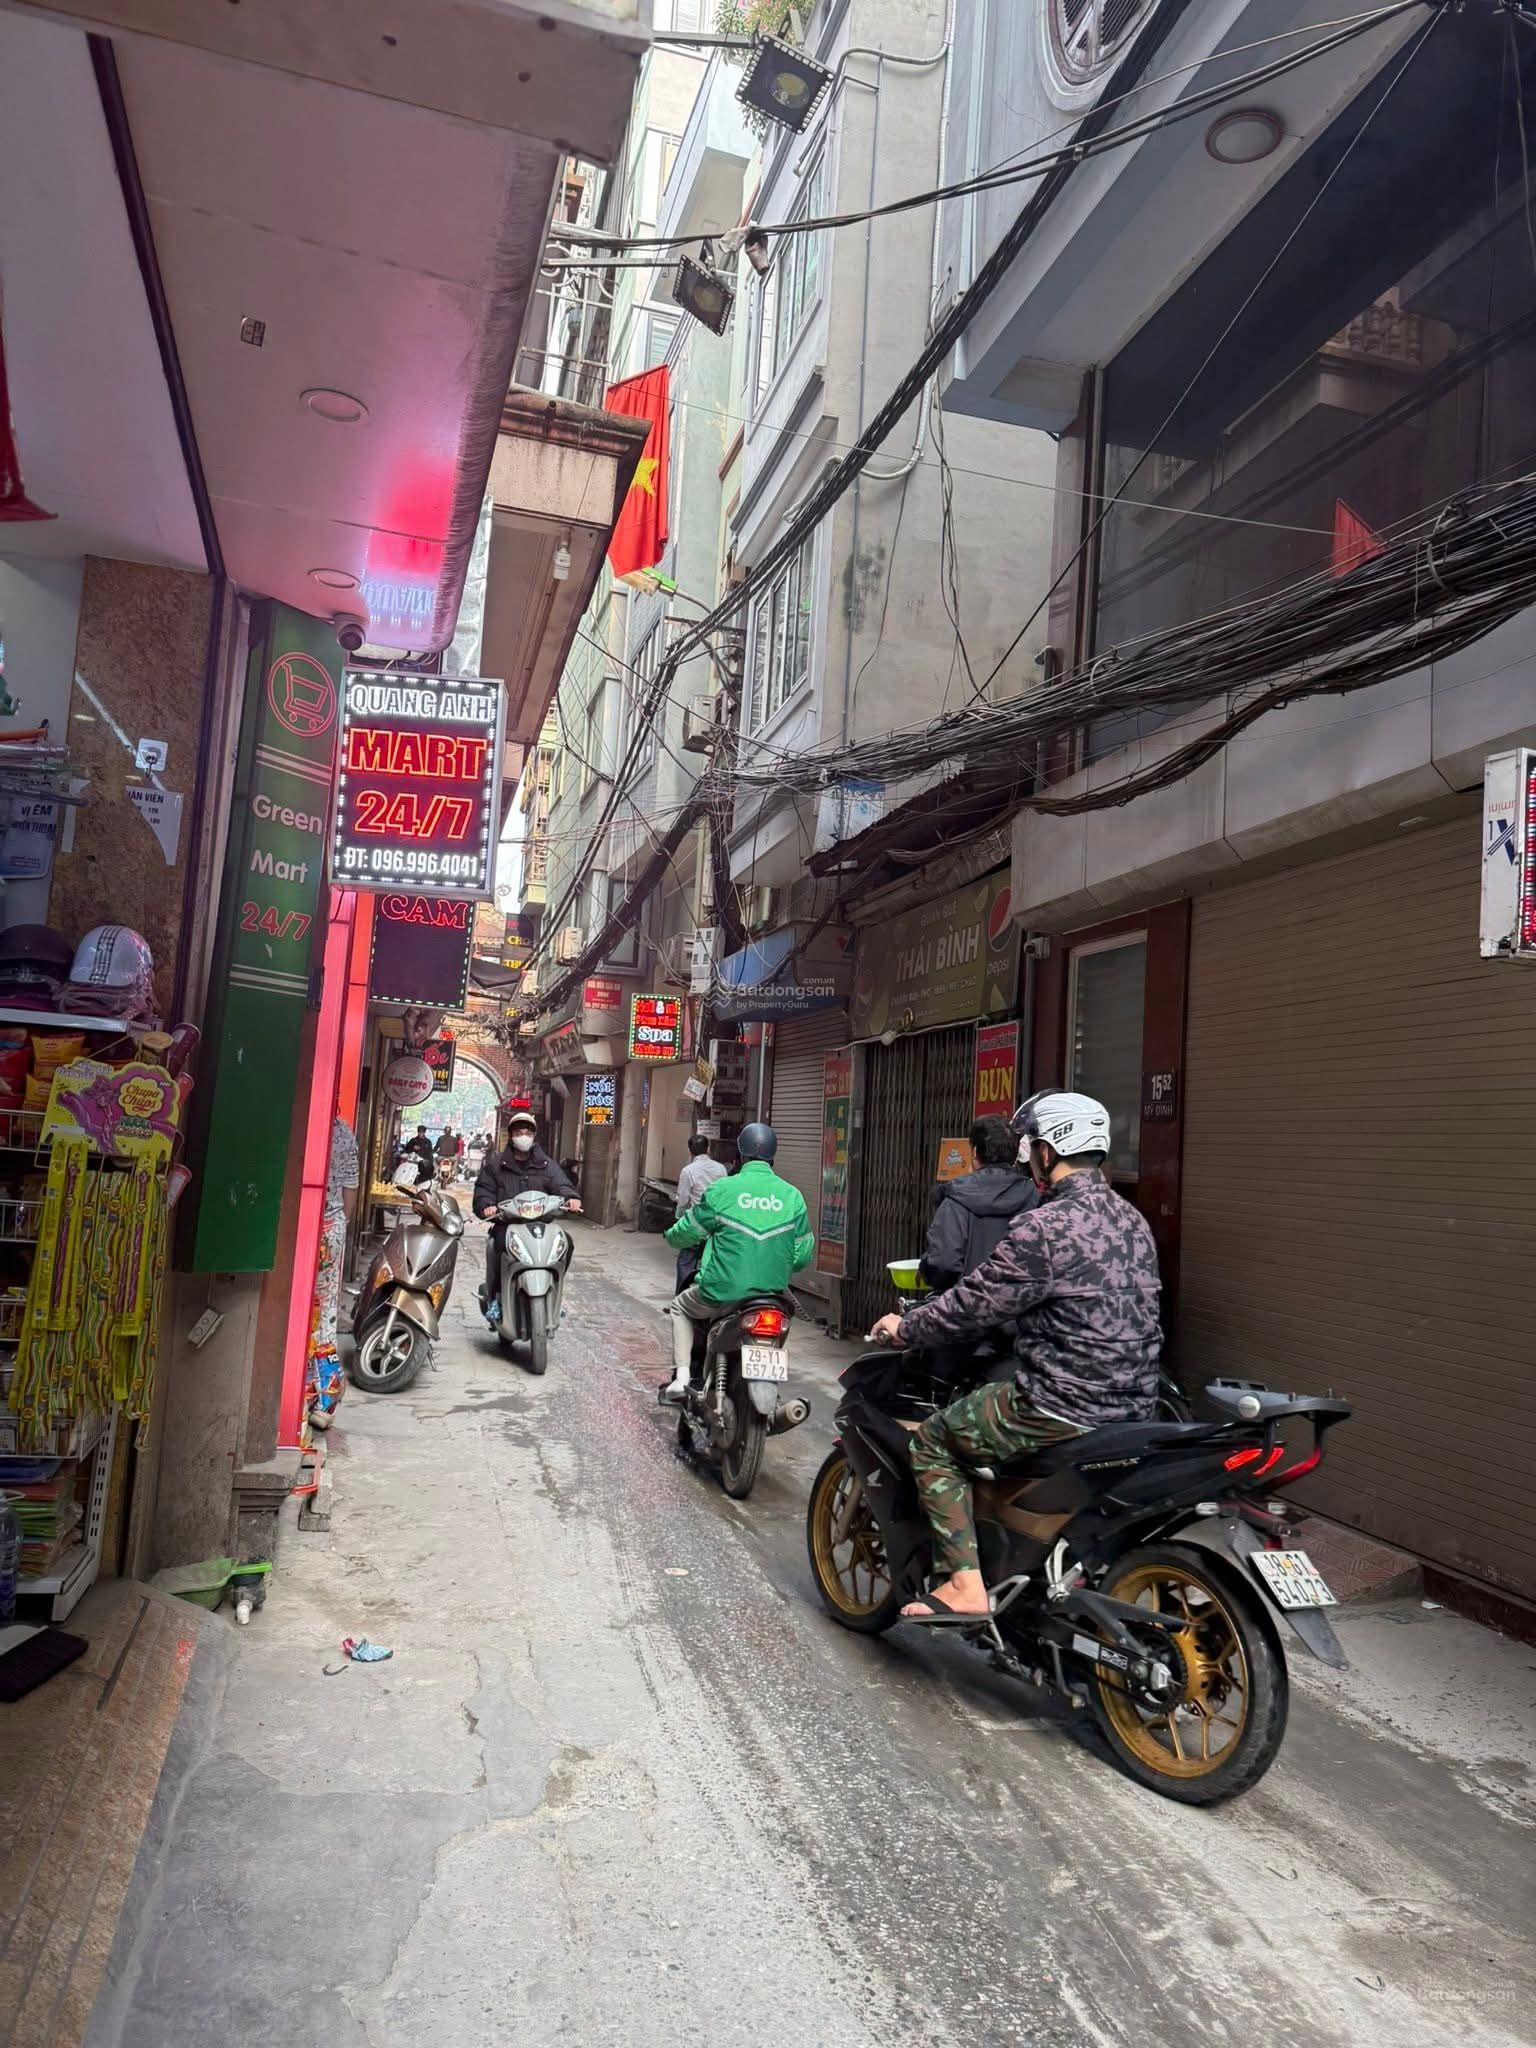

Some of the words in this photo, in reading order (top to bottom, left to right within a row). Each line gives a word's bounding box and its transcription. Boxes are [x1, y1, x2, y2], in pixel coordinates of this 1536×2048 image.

[351, 684, 436, 718] QUANG
[439, 692, 493, 722] ANH
[348, 728, 488, 780] MART
[251, 794, 323, 835] Green
[354, 789, 474, 840] 24/7
[250, 849, 309, 883] Mart
[372, 849, 478, 877] 096.996.4041
[239, 901, 312, 939] 24/7
[896, 936, 932, 983] THÁI
[935, 923, 981, 971] BÌNH
[637, 1025, 673, 1042] Spa
[126, 1084, 160, 1099] Chupa
[978, 1057, 1015, 1103] BÚN
[122, 1095, 157, 1109] Chups
[736, 1192, 784, 1212] Grab
